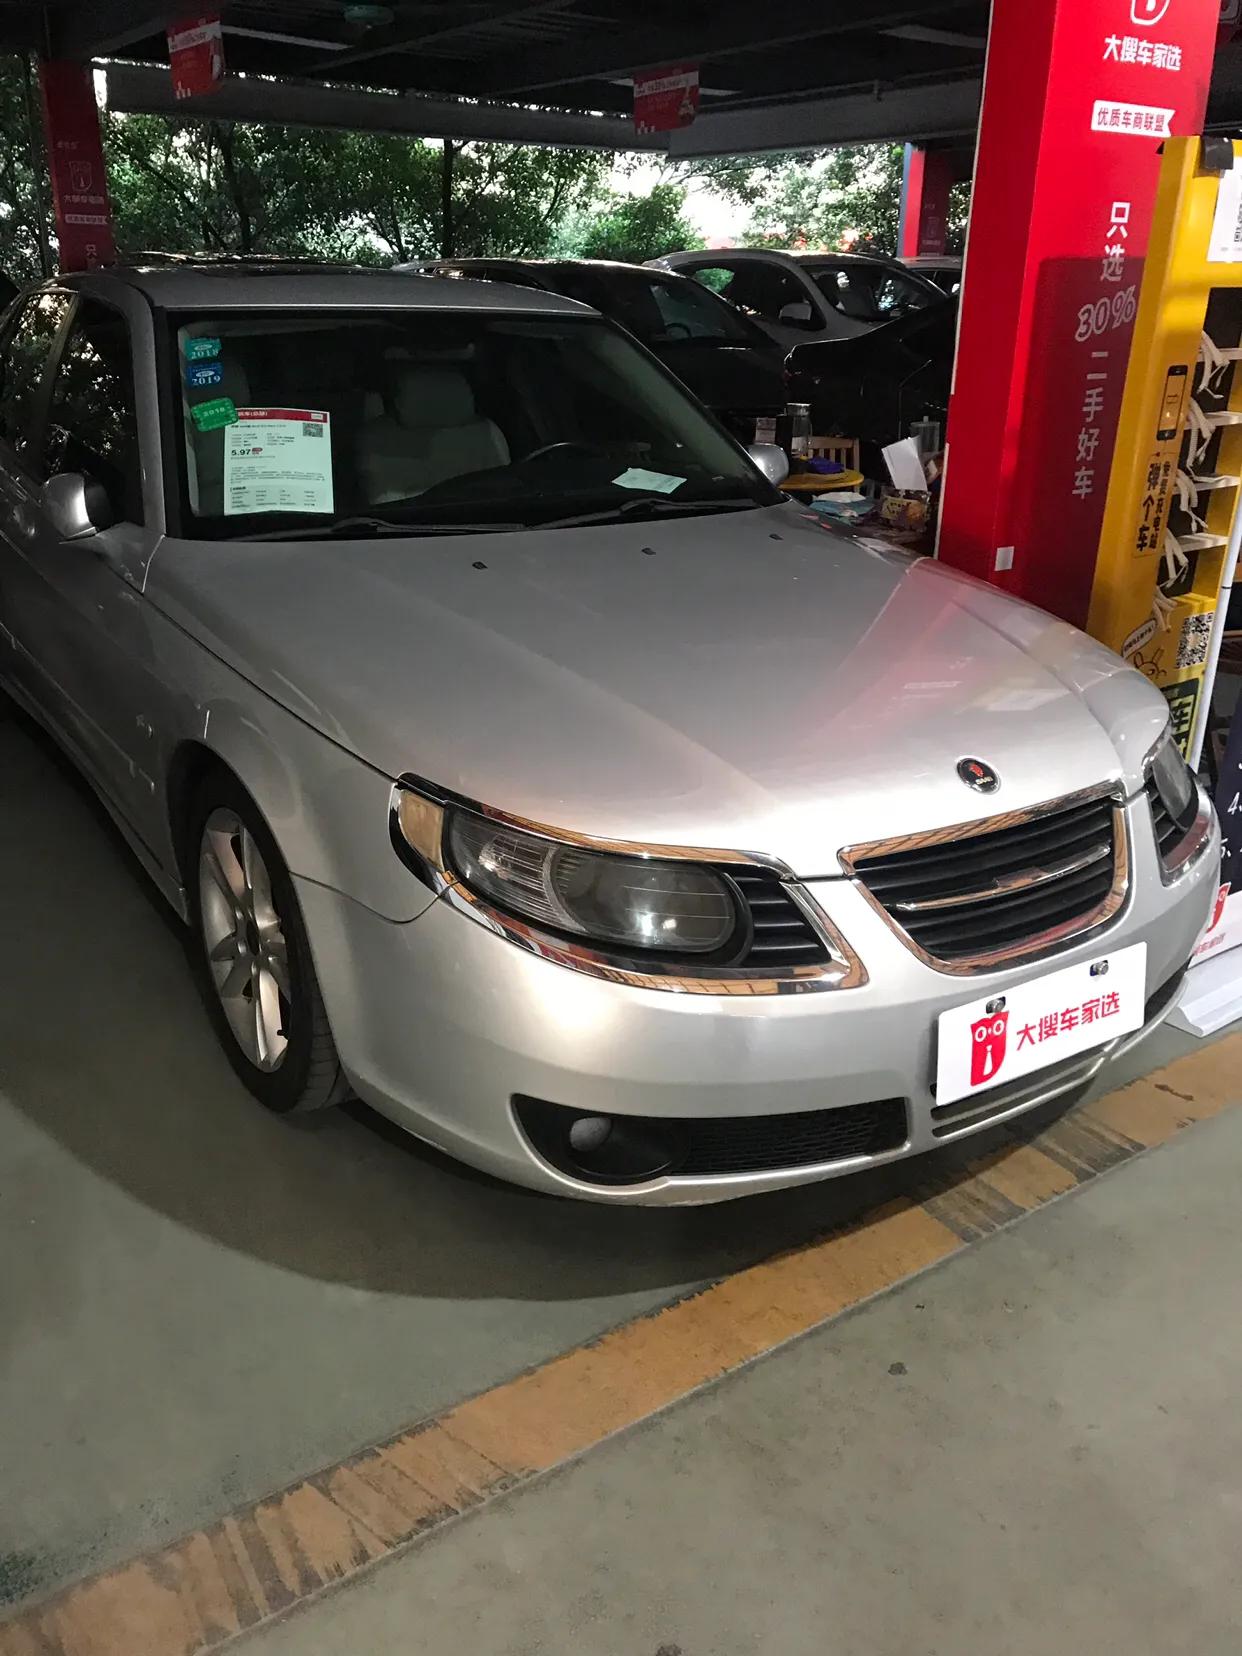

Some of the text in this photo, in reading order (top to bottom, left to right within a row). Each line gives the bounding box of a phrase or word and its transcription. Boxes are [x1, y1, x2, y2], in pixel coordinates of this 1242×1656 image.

[1103, 34, 1182, 71] 大搜车家选
[1097, 107, 1165, 132] 优质车商联盟
[1072, 350, 1109, 500] 二手好车
[231, 448, 251, 457] 5.97
[1016, 991, 1121, 1051] 大搜车家选
